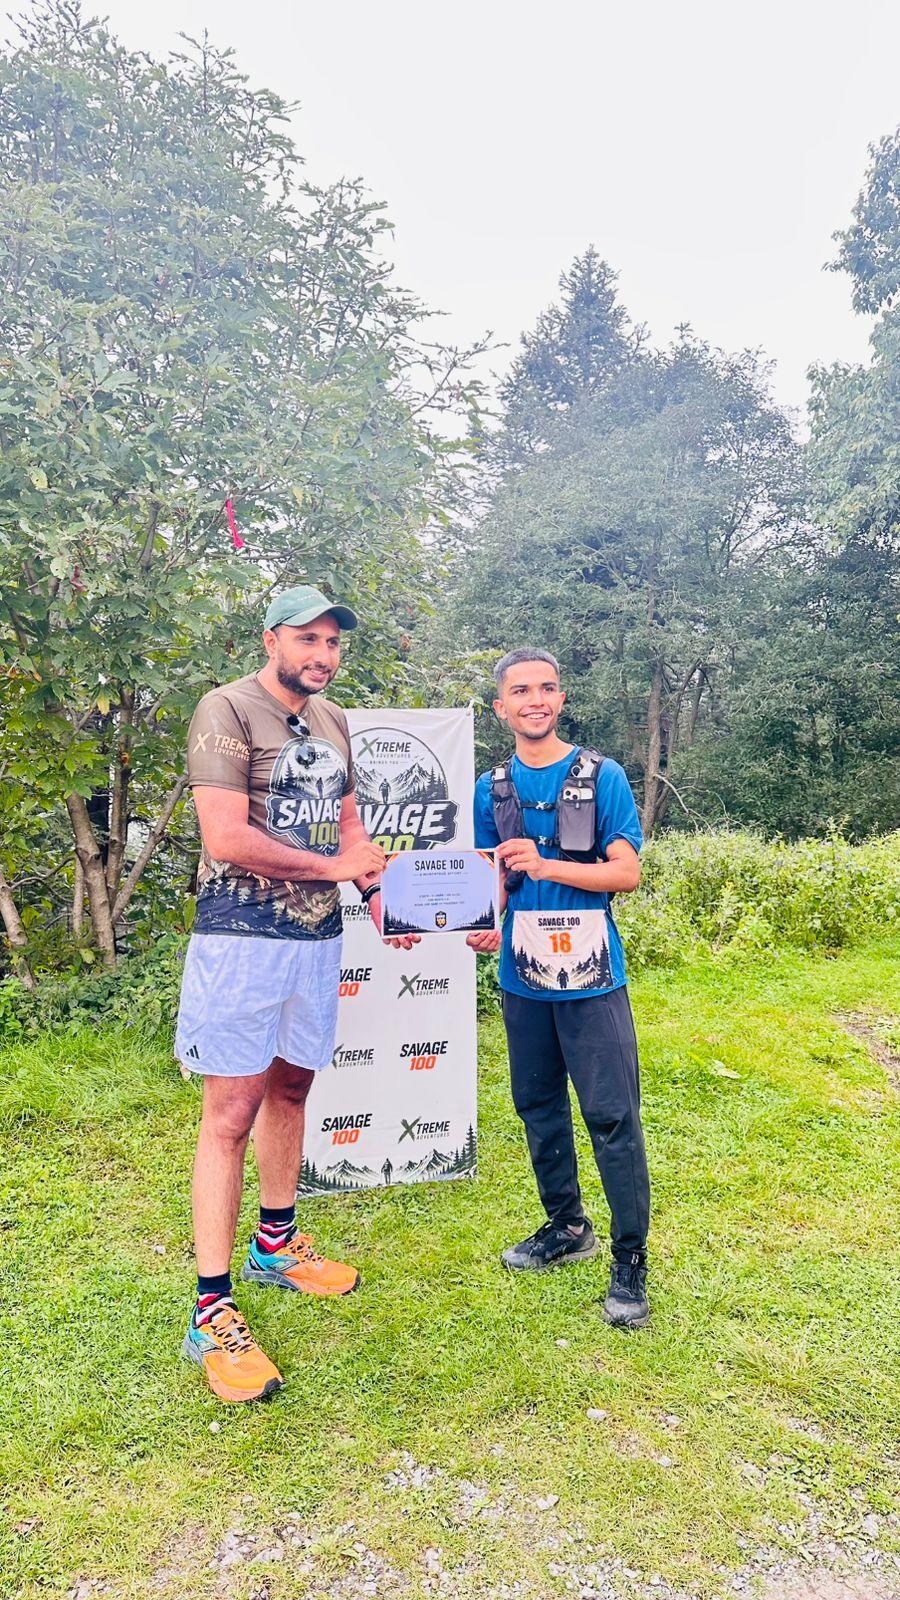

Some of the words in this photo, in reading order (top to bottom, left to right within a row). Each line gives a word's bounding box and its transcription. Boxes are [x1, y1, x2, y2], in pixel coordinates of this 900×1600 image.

[356, 737, 412, 759] XTREME
[276, 798, 342, 828] SAVAG
[356, 803, 451, 838] VAGE
[308, 821, 340, 847] 100
[414, 859, 447, 872] SAVAGE
[450, 859, 465, 870] 100
[537, 917, 566, 927] SAVAGE
[567, 916, 581, 926] 100
[549, 932, 572, 953] 18
[340, 967, 373, 983] VAGE
[338, 982, 360, 997] 00
[397, 972, 450, 1000] XTREME
[415, 988, 449, 996] ADVENTURES
[400, 1040, 449, 1058] SAVAGE
[338, 1060, 374, 1068] ADVENTURES
[409, 1055, 437, 1071] 100
[321, 1113, 373, 1132] SAVAGE
[397, 1116, 451, 1144] XTREME
[331, 1129, 361, 1145] 100
[416, 1132, 450, 1140] ADVENTURES
